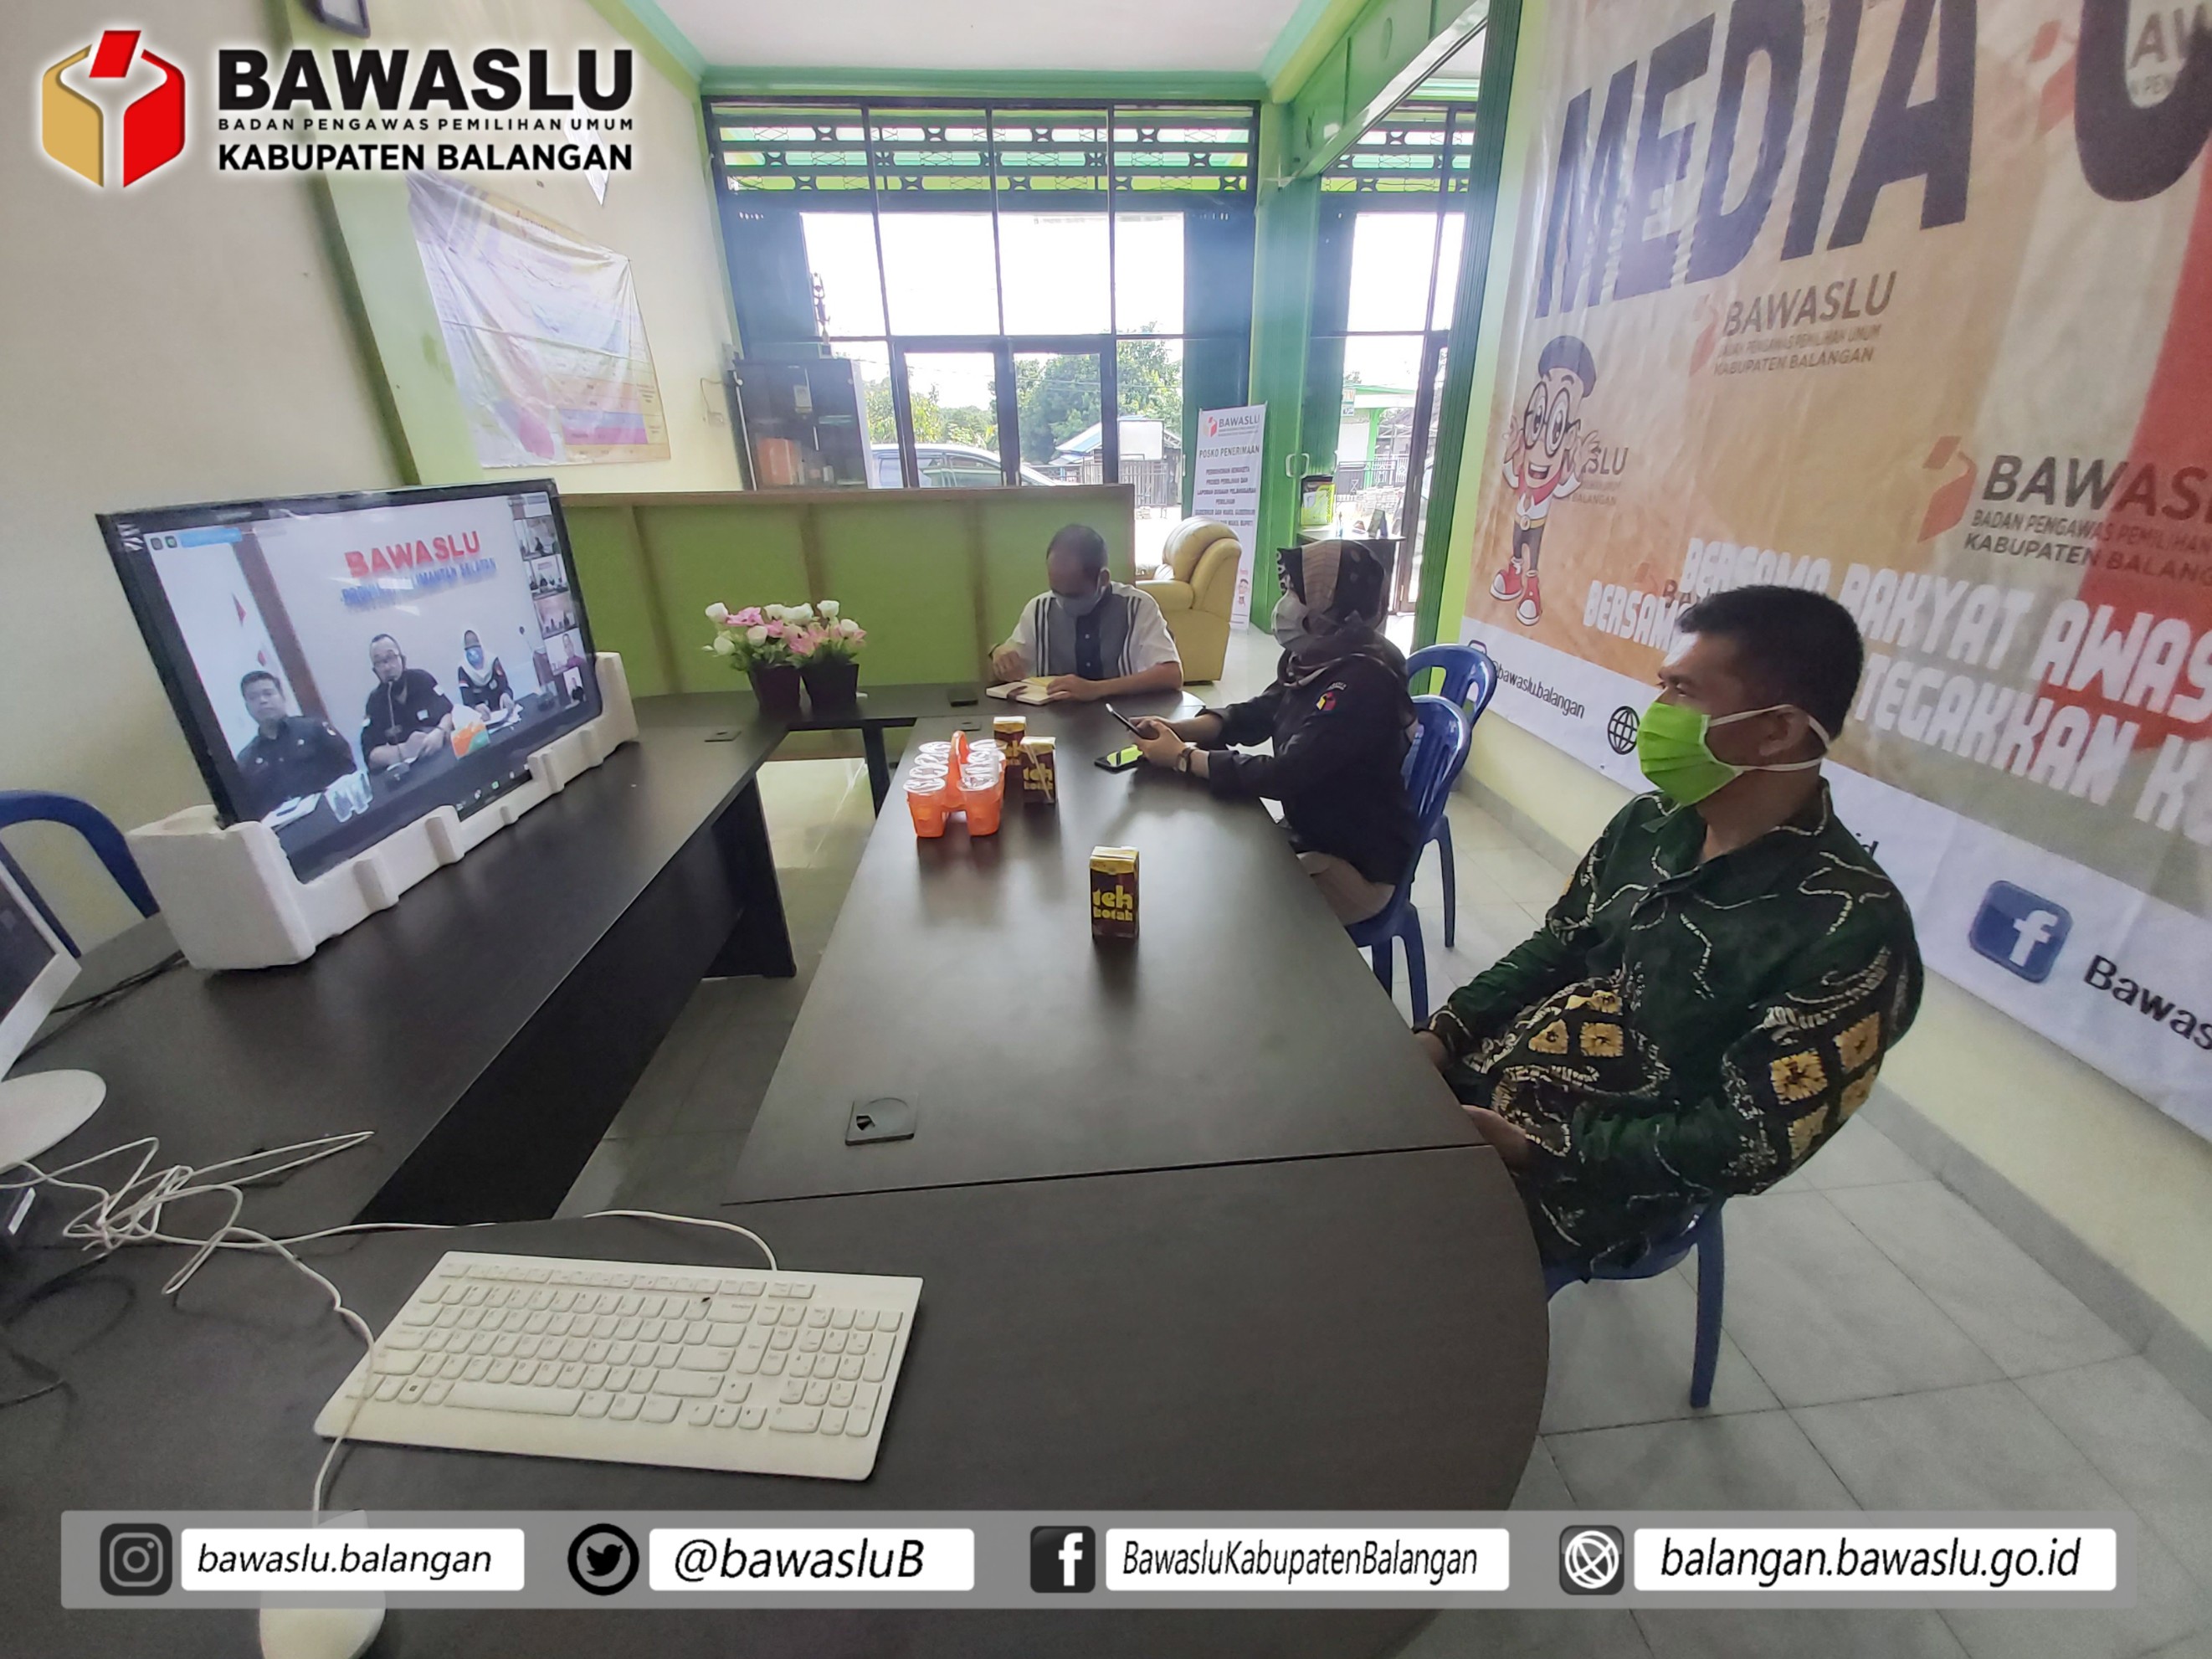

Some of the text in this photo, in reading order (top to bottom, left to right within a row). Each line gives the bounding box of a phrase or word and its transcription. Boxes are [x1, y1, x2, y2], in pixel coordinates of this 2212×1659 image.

[1536, 0, 1977, 318] MEDIA
[1723, 270, 1897, 336] BAWASLU
[1714, 347, 1875, 376] KABUPATEN BALANGAN
[1219, 413, 1260, 429] BAWASLU
[1199, 444, 1260, 459] POSKO PENERIMAAN
[1982, 455, 2212, 524] BAWAS
[1972, 508, 2025, 532] BADAN
[2025, 514, 2114, 542] PENGAWAS
[344, 531, 481, 578] BAWASLU
[1963, 532, 2098, 567] KABUPATEN
[1838, 562, 2035, 670] RAKYAT
[1583, 580, 1691, 655] BERSAM
[1855, 652, 2141, 807] TEGAKKAN
[1092, 884, 1133, 910] teh
[1093, 906, 1133, 922] kotak
